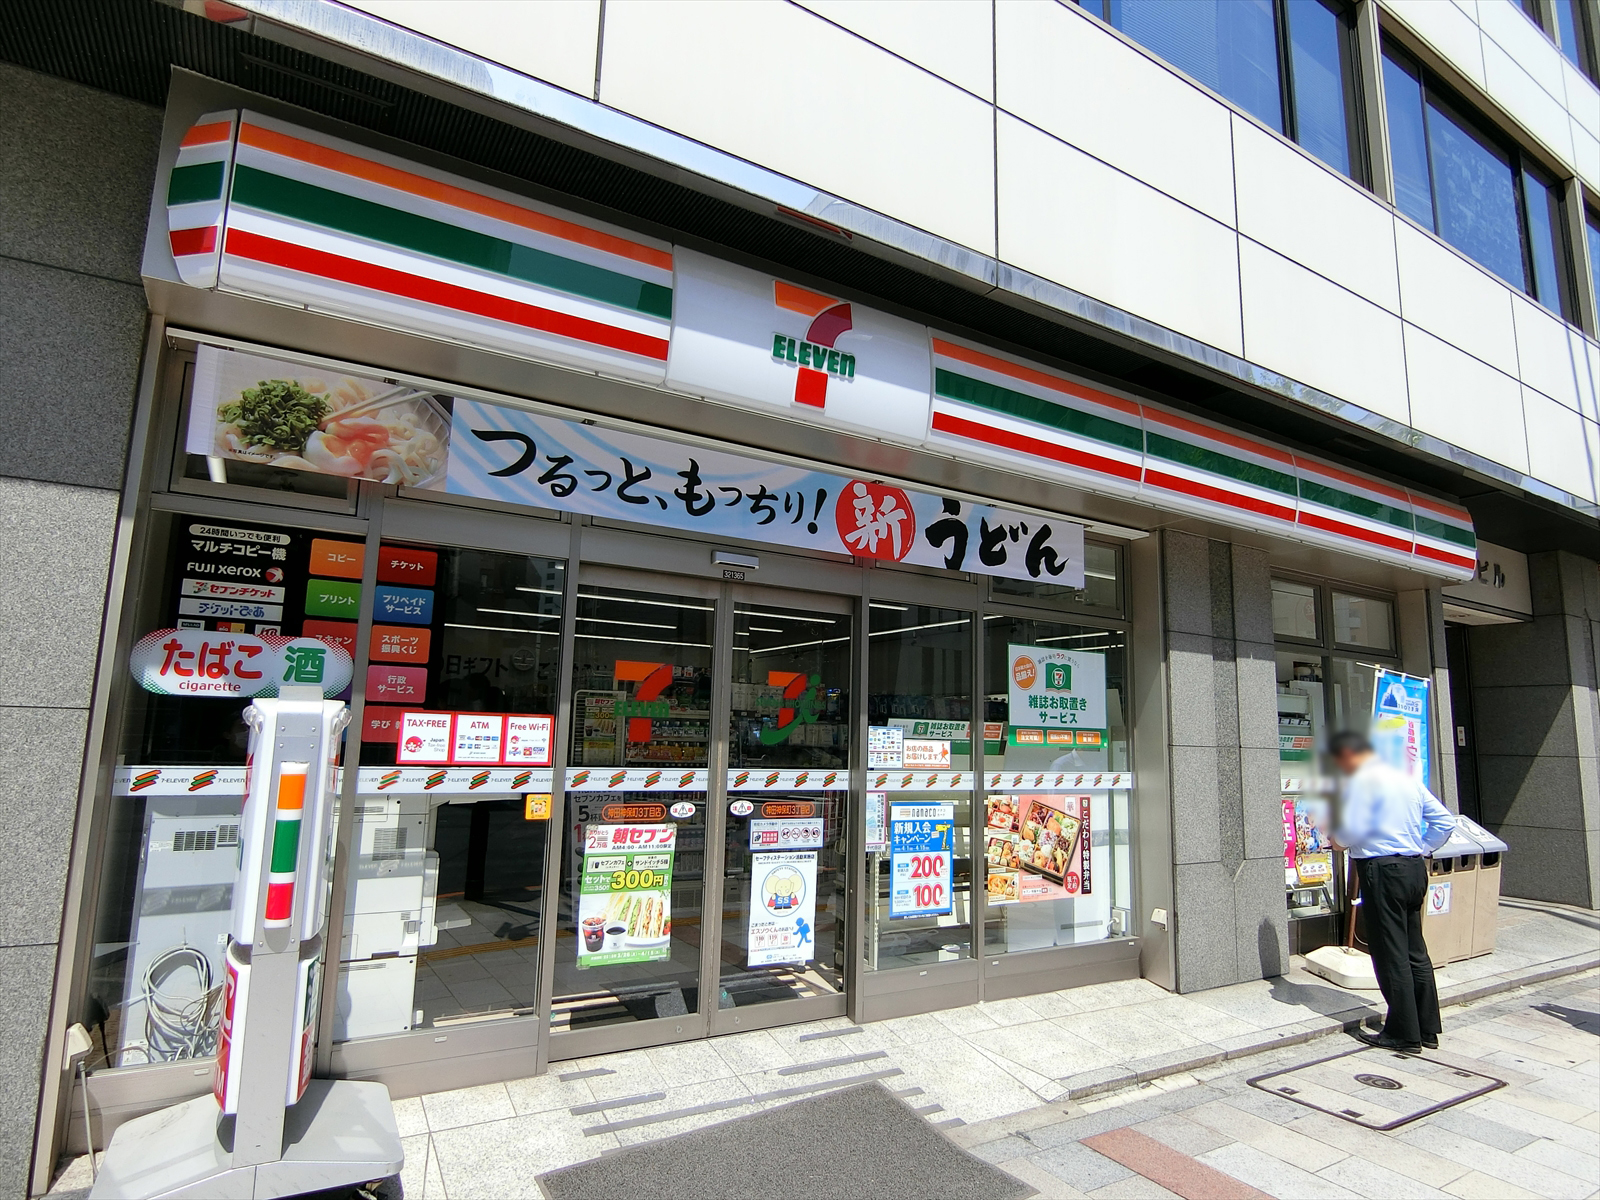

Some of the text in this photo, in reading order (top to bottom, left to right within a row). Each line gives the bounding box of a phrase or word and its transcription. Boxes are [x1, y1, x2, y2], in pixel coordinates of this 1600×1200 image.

[200, 527, 281, 543] 24時間いつでも便利
[846, 482, 907, 560] 新
[925, 498, 1069, 578] うどん
[191, 540, 286, 561] マルチコピー機
[327, 553, 356, 563] コピー
[187, 562, 261, 577] FUJI xerox
[391, 560, 424, 571] チケット
[723, 570, 745, 580] 321365
[210, 584, 276, 598] セブンチケット
[320, 594, 356, 605] プリント
[383, 595, 426, 606] プリペイド
[199, 603, 265, 618] チケットぴあ
[385, 605, 422, 615] サービス
[381, 635, 419, 645] スポーツ
[381, 644, 417, 654] 振興くじ
[160, 638, 327, 684] たばこ 酒
[387, 675, 407, 684] 行政
[179, 680, 241, 693] cigarette
[377, 684, 415, 694] サービス
[1029, 695, 1087, 711] 雑誌お取置き
[407, 719, 447, 728] TAX-FREE
[1039, 712, 1078, 724] サービス
[371, 720, 391, 729] 学び
[470, 721, 490, 729] ATM
[510, 722, 549, 731] Free Wi-Fi
[930, 722, 966, 731] 雑誌お取置き
[906, 745, 934, 753] お店の商品
[573, 794, 622, 802] セブンカフェを
[911, 808, 937, 817] nanaco
[893, 821, 931, 834] 新規入会
[612, 828, 674, 844] 朝セブン
[893, 834, 931, 844] キャンペーン
[911, 855, 944, 878] 200
[584, 875, 611, 884] セットで
[611, 869, 664, 890] 300円
[914, 883, 943, 907] 100
